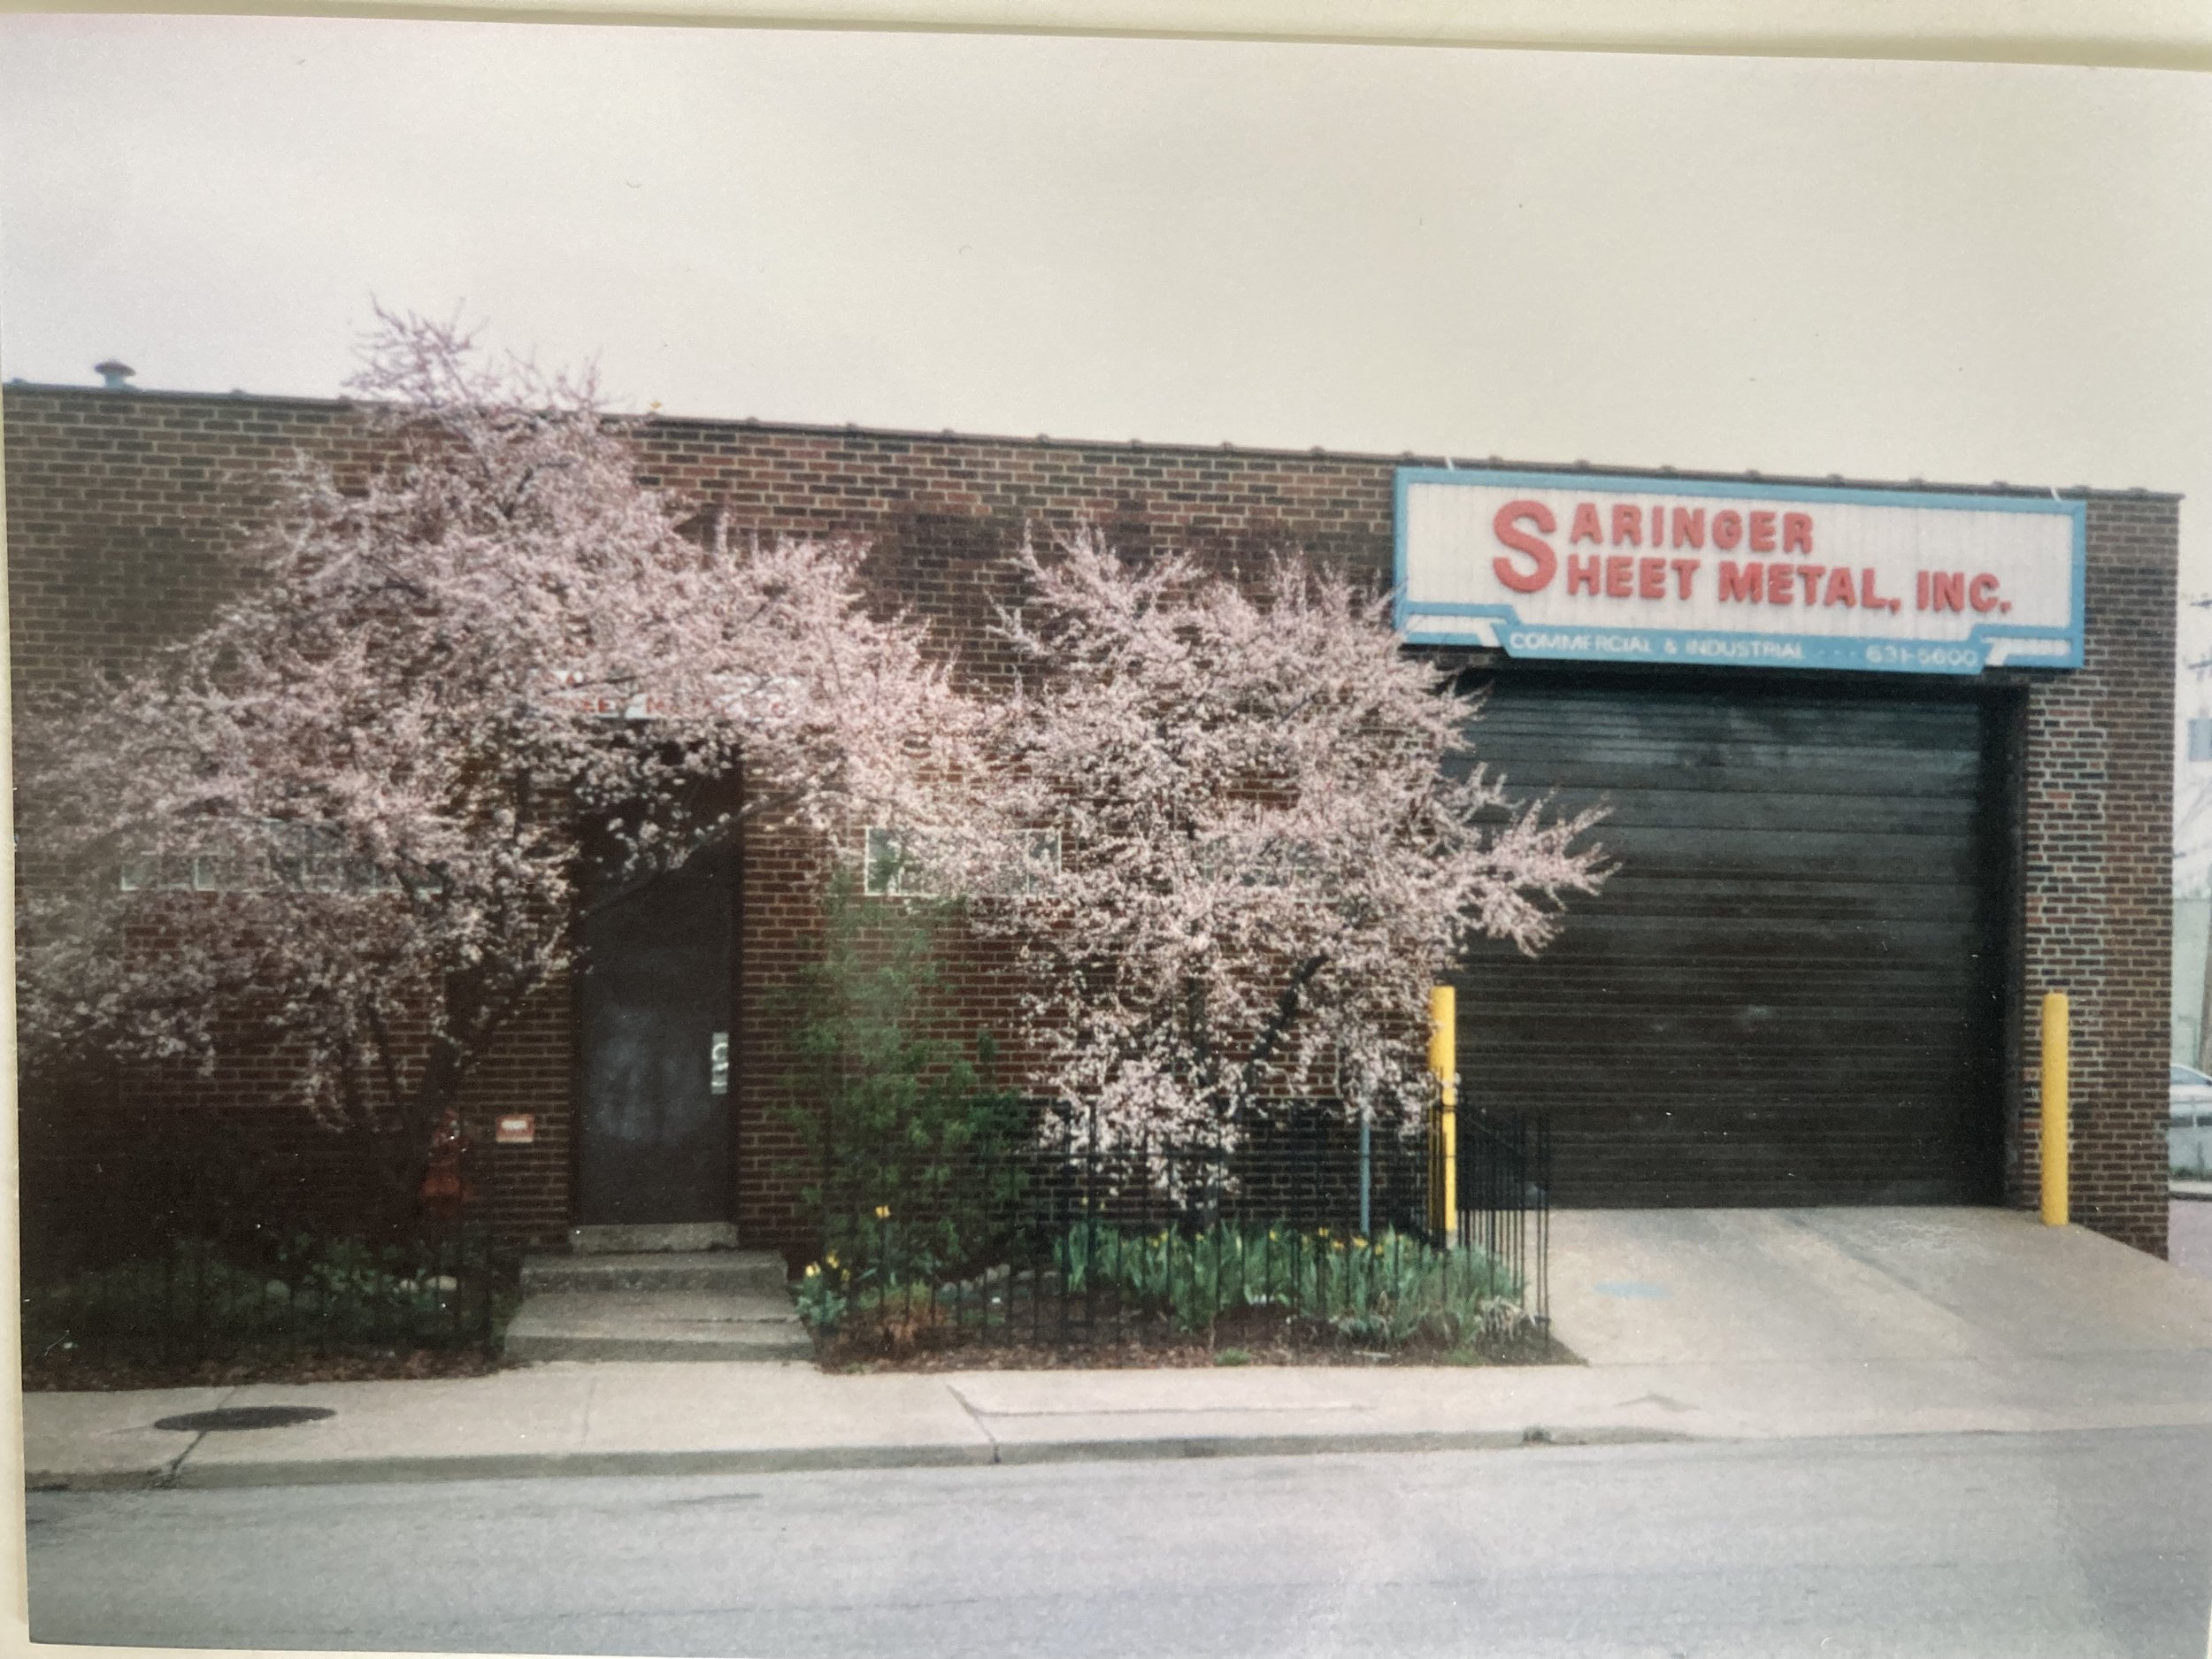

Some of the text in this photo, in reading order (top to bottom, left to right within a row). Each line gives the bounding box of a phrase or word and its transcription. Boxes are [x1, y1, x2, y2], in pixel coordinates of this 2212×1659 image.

[1719, 562, 1901, 611] METAL,
[1916, 572, 2013, 614] INC.
[1509, 631, 1655, 654] COMMERCIAL
[1686, 639, 1804, 660] INDUSTRIAL
